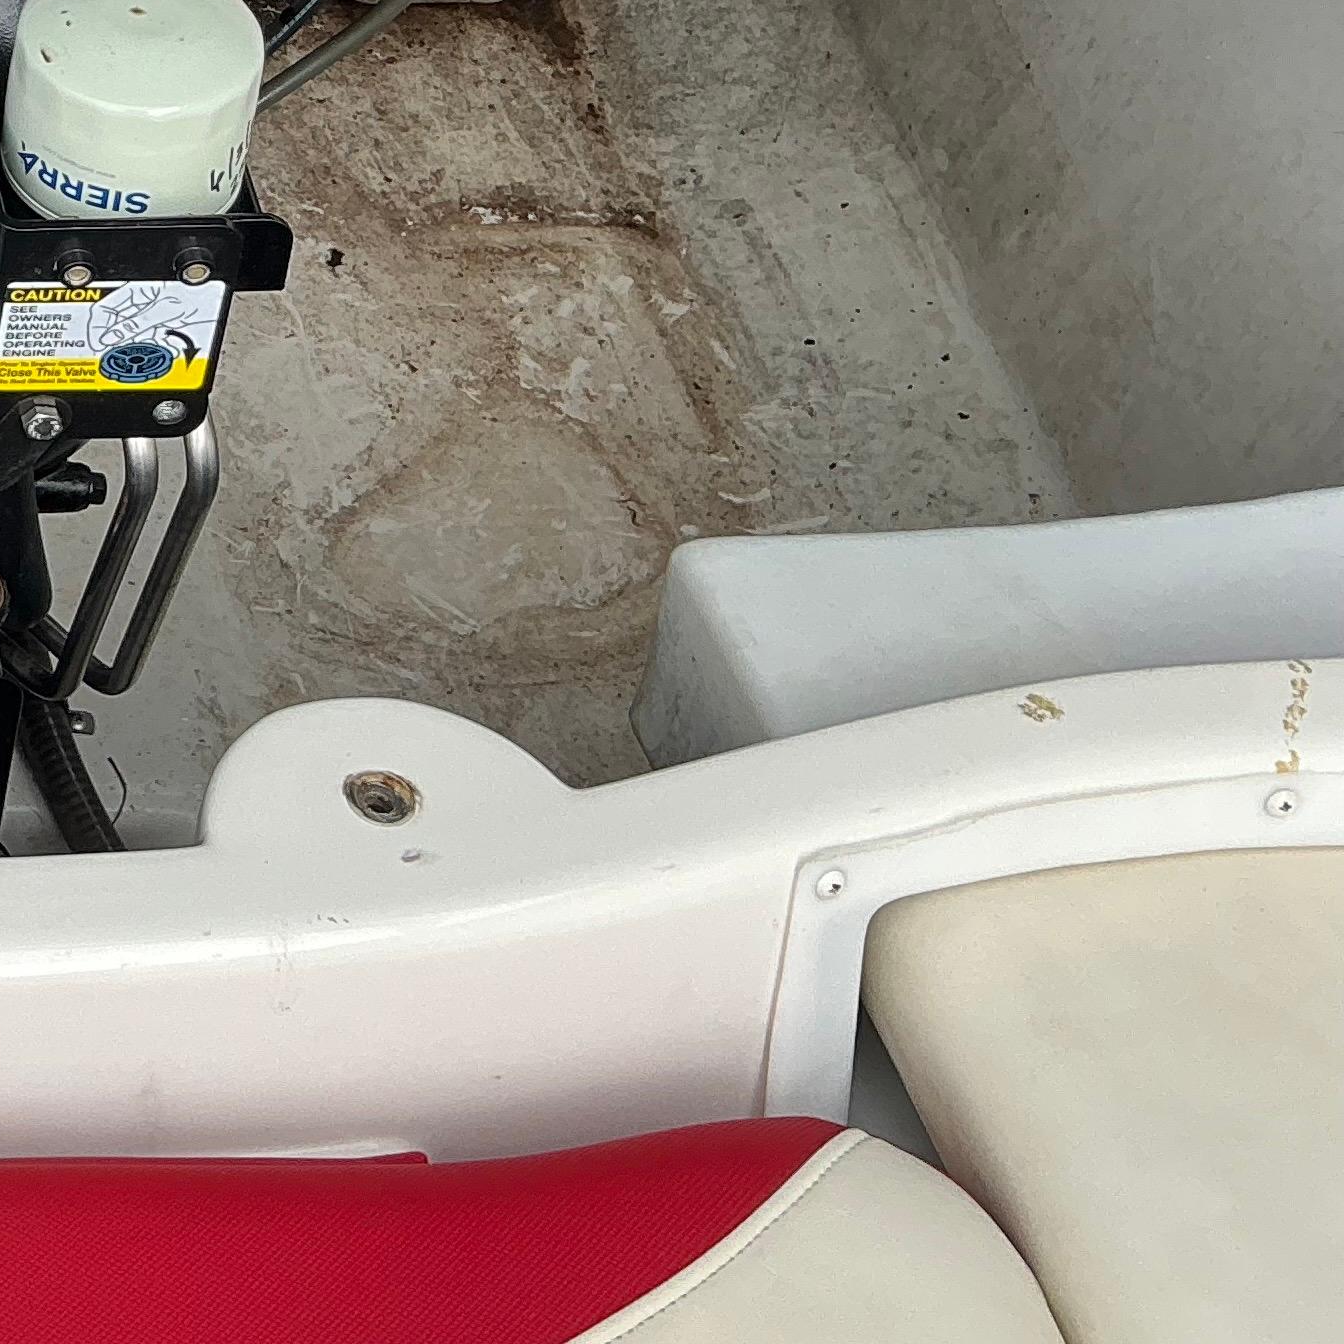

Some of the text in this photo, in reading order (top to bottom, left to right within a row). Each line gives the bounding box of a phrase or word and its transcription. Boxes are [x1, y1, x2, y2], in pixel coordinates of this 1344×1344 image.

[17, 151, 151, 215] SIERRA
[10, 288, 101, 302] CAUTION
[9, 305, 38, 313] SEE
[8, 314, 72, 322] OWNERS
[6, 323, 68, 331] MANUAL
[5, 331, 63, 340] BEFORE
[3, 340, 86, 349] OPERATING
[2, 349, 56, 357] ENGINE
[36, 367, 62, 377] This
[65, 367, 97, 377] Valve
